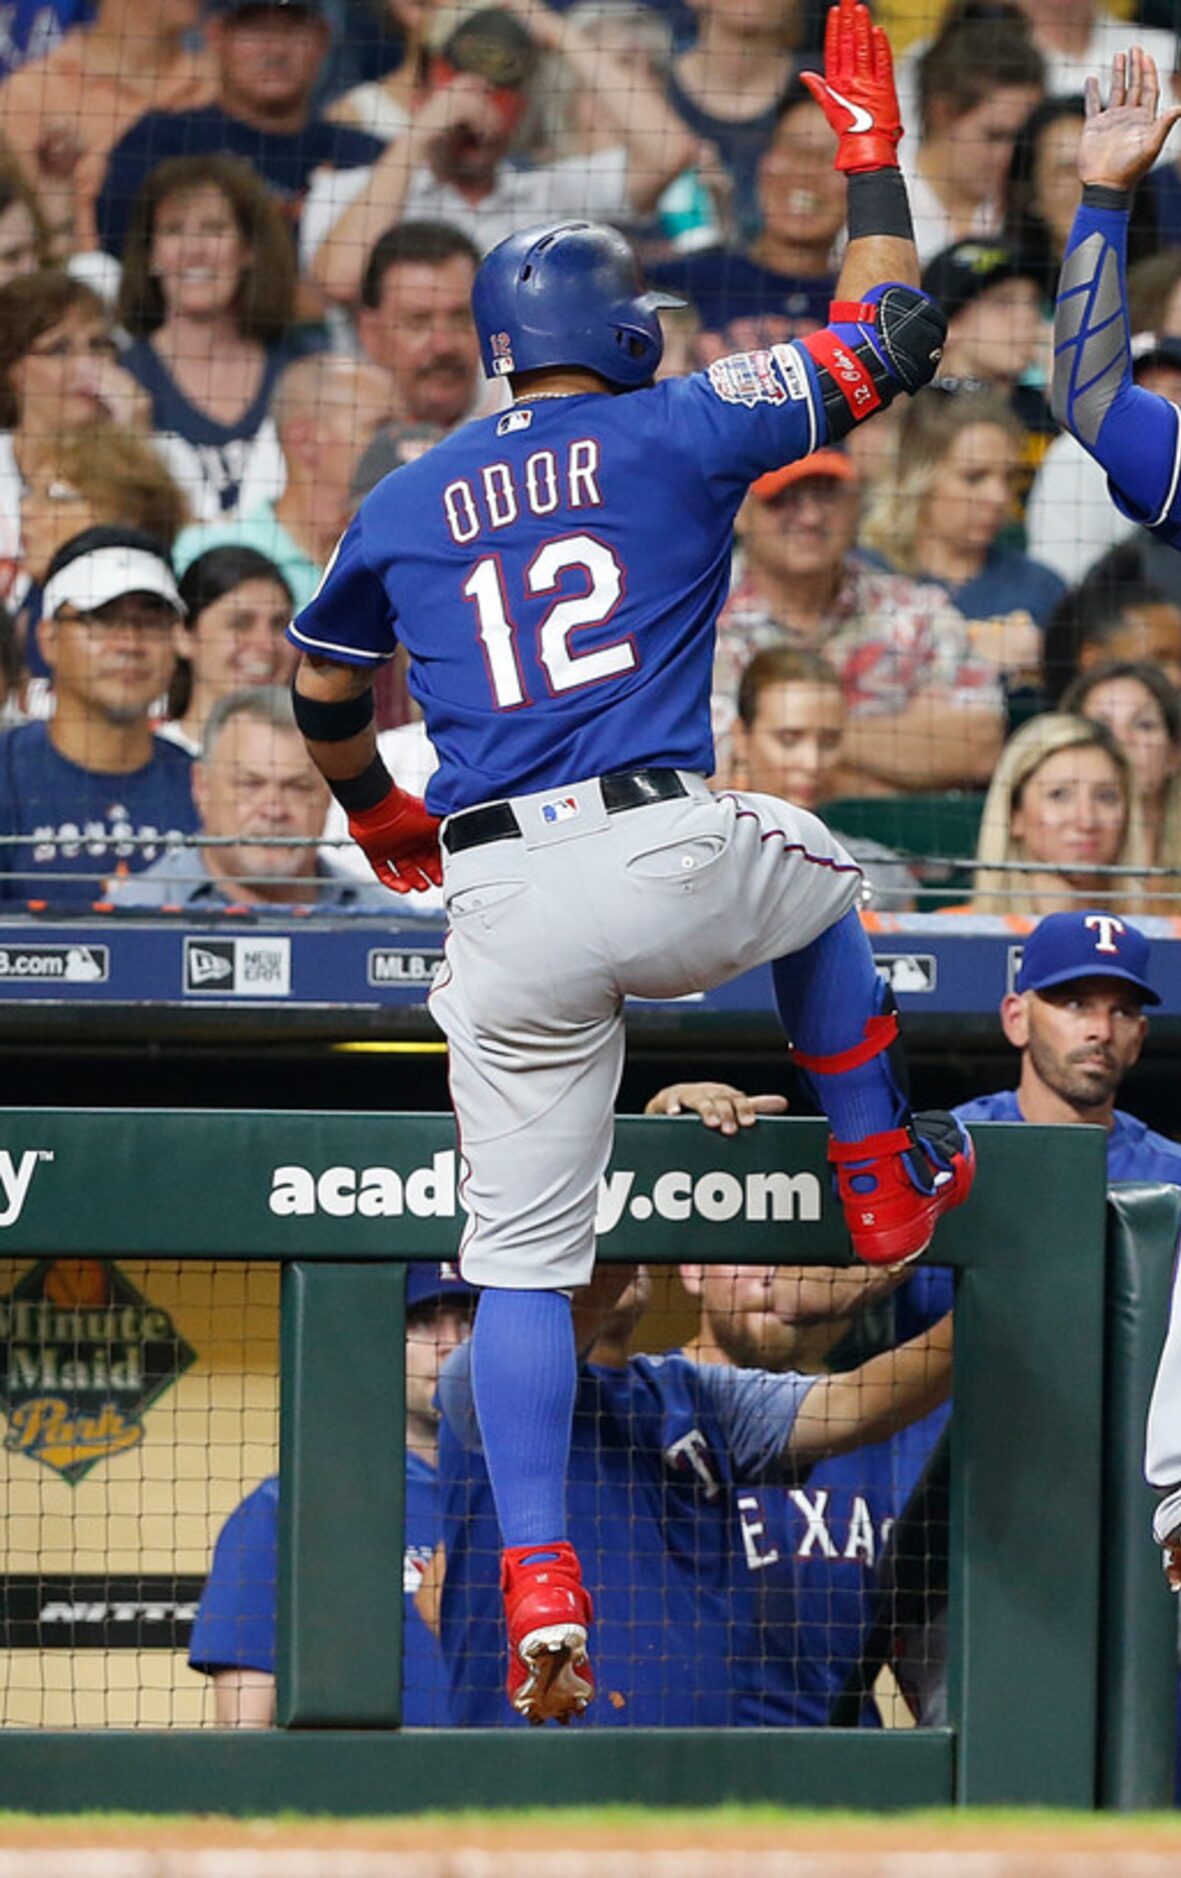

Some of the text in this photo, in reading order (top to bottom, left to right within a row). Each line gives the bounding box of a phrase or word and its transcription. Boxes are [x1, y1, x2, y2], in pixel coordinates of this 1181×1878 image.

[490, 332, 511, 356] 12
[443, 438, 603, 546] ODOR
[462, 530, 641, 712] 12
[1083, 914, 1126, 955] T
[268, 1149, 821, 1236] acady.com
[10, 1346, 142, 1390] Maid
[6, 1397, 143, 1450] Park
